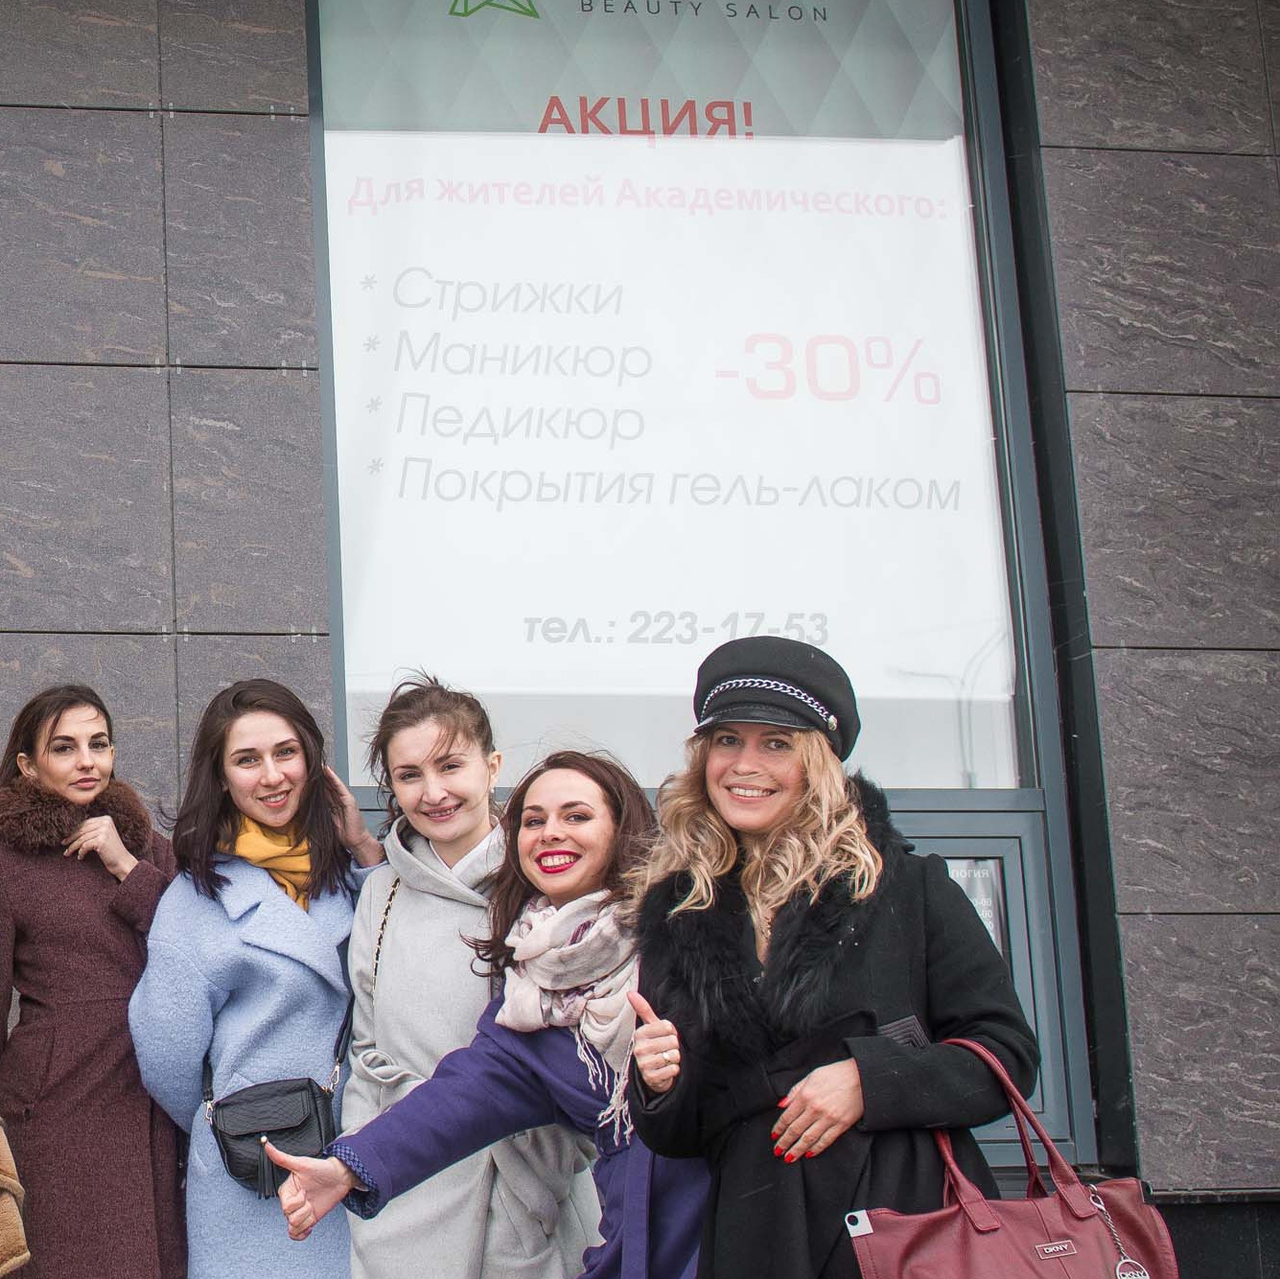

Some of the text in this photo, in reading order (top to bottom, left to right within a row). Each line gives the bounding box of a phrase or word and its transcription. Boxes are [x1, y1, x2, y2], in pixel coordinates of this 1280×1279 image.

[726, 3, 829, 22] SALON
[537, 96, 754, 148] АКЦИЯ!
[347, 173, 947, 221] Для жителей Академического:
[392, 266, 624, 322] Стрижки
[393, 330, 653, 387] Маникюр
[714, 333, 943, 406] -30%
[395, 392, 646, 450] Педикюр
[397, 456, 962, 512] Покрытия гель-лаком
[523, 610, 829, 646] тел.: 223-17-53
[1043, 1244, 1068, 1254] DKNY
